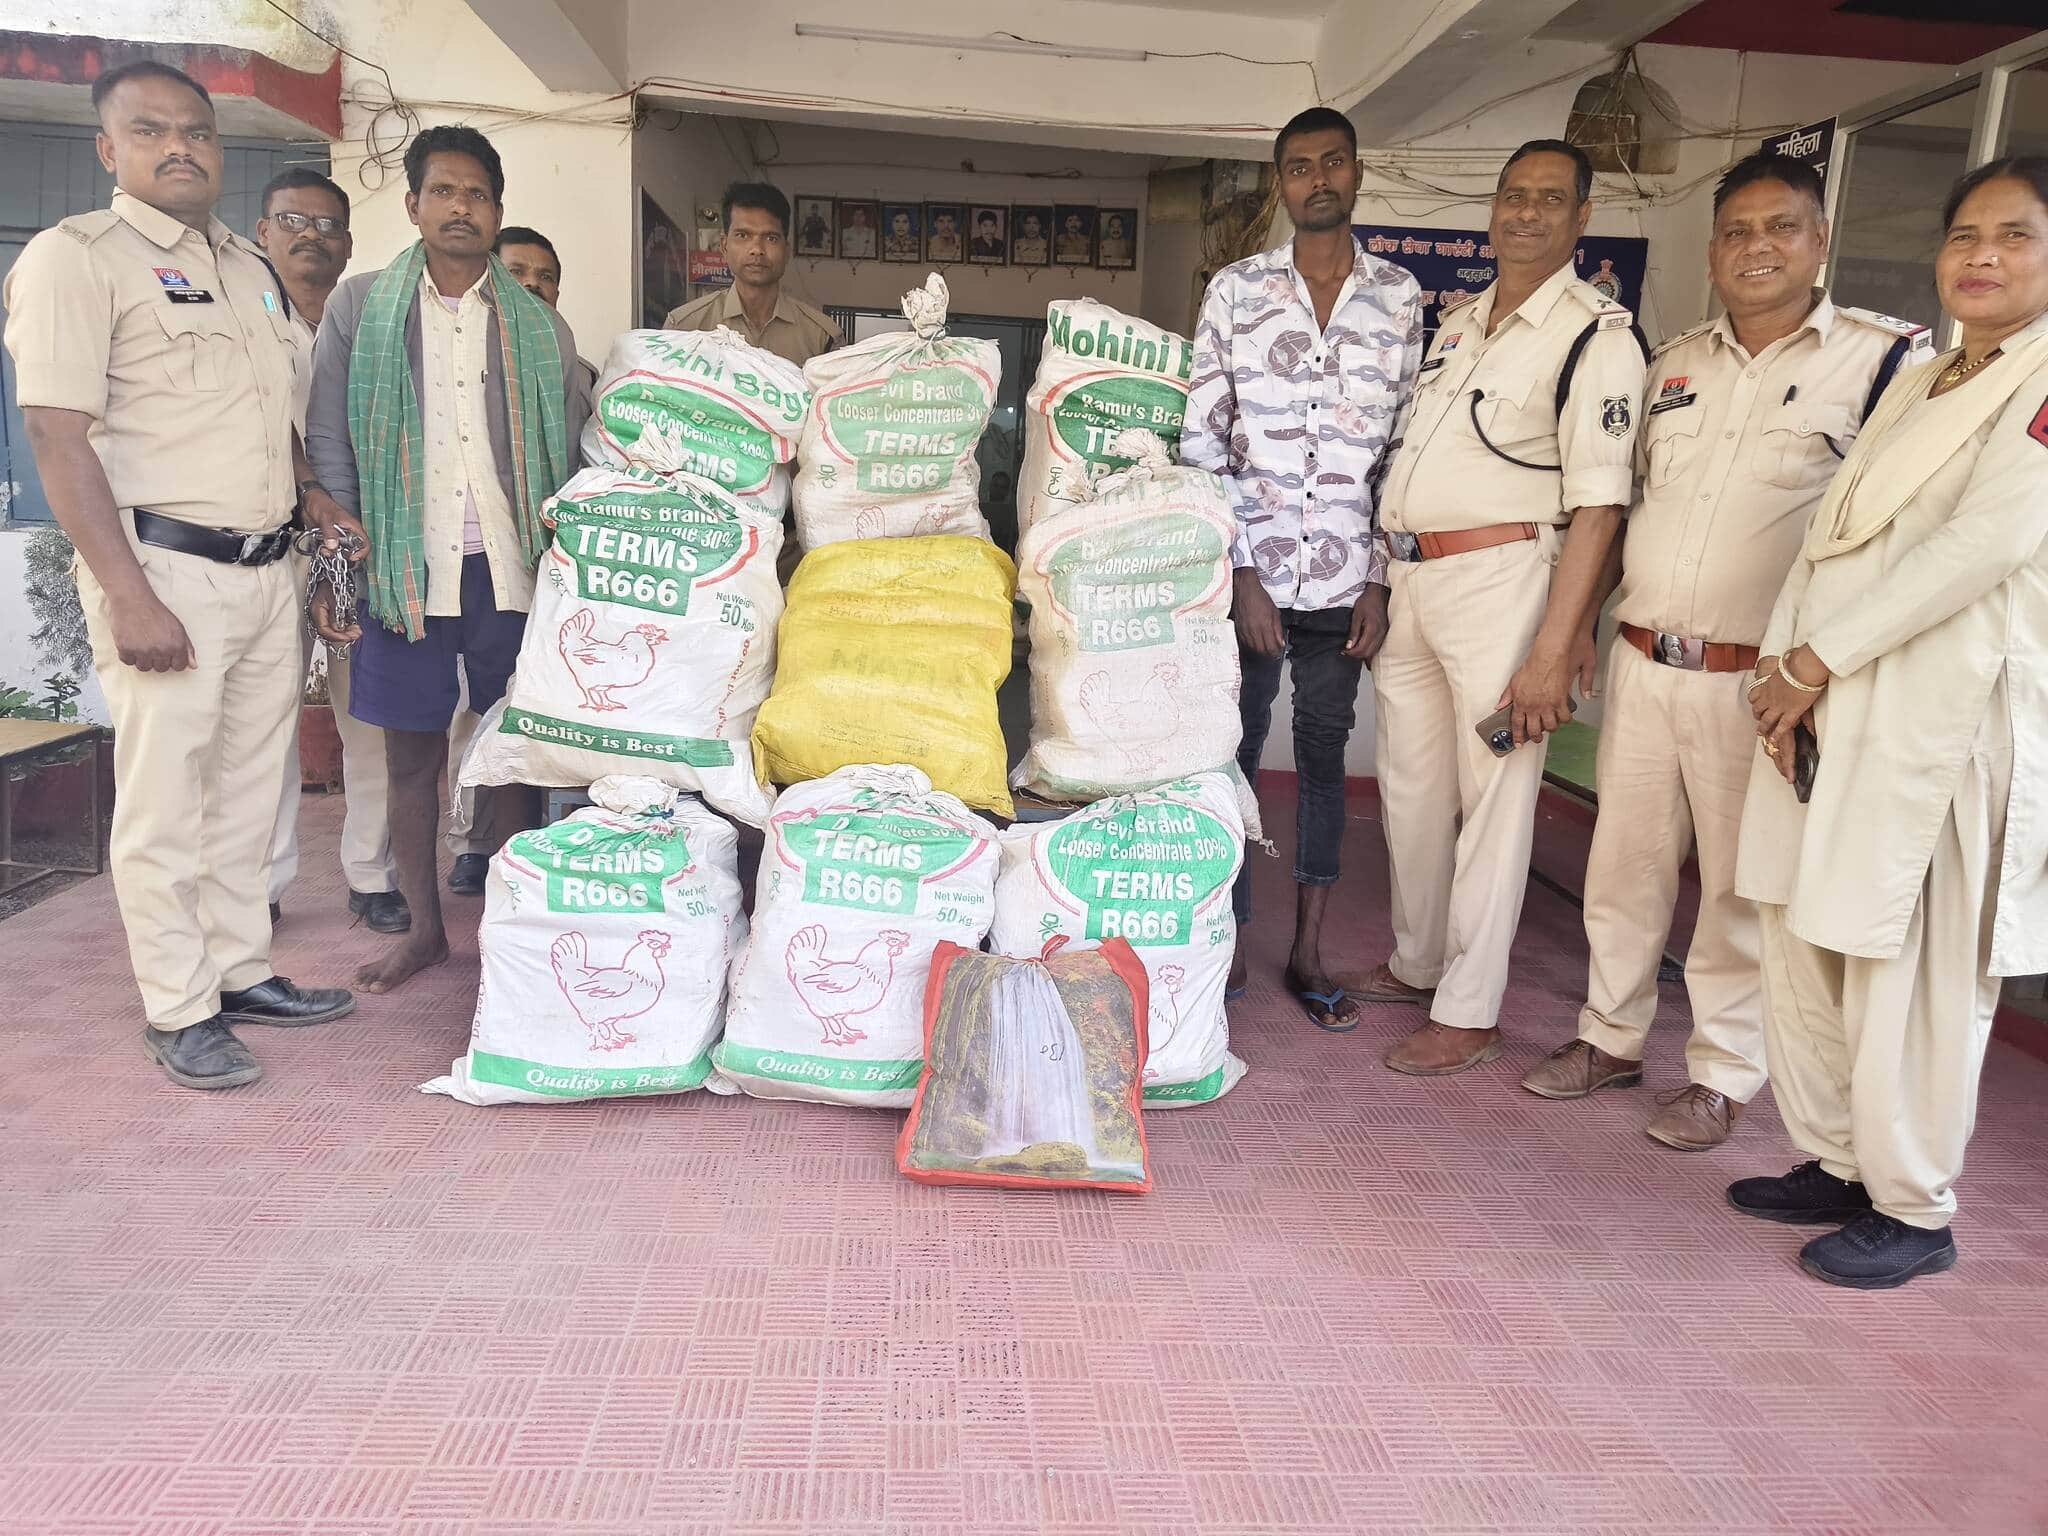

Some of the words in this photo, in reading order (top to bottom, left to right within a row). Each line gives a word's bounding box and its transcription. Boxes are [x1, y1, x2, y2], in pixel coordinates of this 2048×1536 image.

[1776, 130, 1822, 158] महिला
[1368, 234, 1399, 254] लोक
[1401, 236, 1432, 254] सेवा
[1435, 238, 1476, 258] गारंटी
[1049, 308, 1170, 373] Mohini
[912, 380, 964, 401] Brand
[608, 397, 656, 426] Looser
[837, 398, 879, 421] Looser
[884, 403, 963, 424] Concentrate
[1081, 393, 1146, 420] Ramu's
[1152, 406, 1183, 426] Bra
[864, 430, 957, 456] TERMS
[871, 463, 940, 488] R666
[576, 523, 699, 573] TERMS
[700, 529, 736, 550] 30%
[586, 564, 679, 608] R666
[1076, 580, 1176, 612] TERMS
[720, 603, 741, 626] 50
[1091, 616, 1161, 644] R666
[1193, 629, 1207, 644] 50
[517, 716, 596, 745] Quality
[602, 734, 620, 749] is
[626, 737, 677, 757] Best
[1135, 811, 1197, 834] Brand
[552, 848, 665, 874] TERMS
[815, 829, 923, 871] TERMS
[1058, 836, 1105, 860] Looser
[1110, 840, 1192, 862] Concentrate
[1196, 838, 1228, 860] 30%
[563, 876, 649, 907] R666
[819, 868, 902, 906] R666
[934, 891, 950, 902] Net
[952, 892, 985, 905] Weight
[1092, 869, 1194, 901] TERMS
[686, 900, 704, 917] 50
[936, 907, 957, 923] 50
[1101, 908, 1178, 940] R666
[526, 1068, 605, 1092] Quality
[611, 1076, 629, 1090] is
[633, 1073, 681, 1088] Best
[756, 1056, 834, 1081] Quality
[840, 1067, 857, 1080] is
[1156, 1087, 1197, 1097] Best
